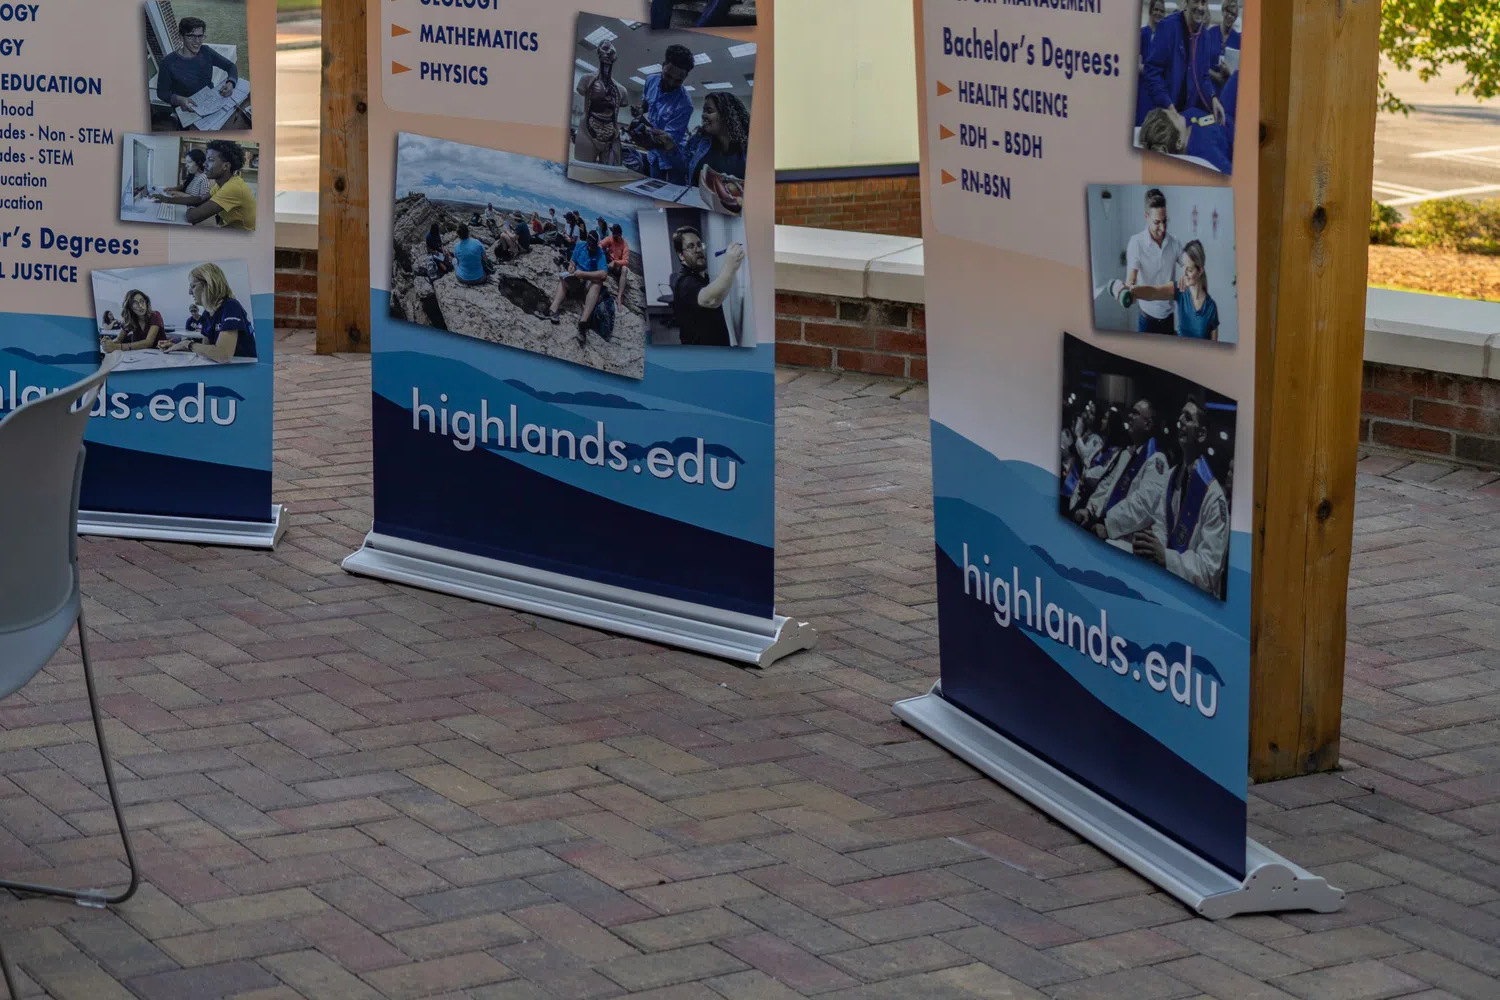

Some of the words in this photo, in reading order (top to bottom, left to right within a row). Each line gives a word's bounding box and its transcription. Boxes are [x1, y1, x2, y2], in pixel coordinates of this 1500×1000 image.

[419, 23, 538, 51] MATHEMATICS
[1041, 36, 1119, 79] Degrees:
[0, 73, 101, 95] EDUCATION
[420, 61, 488, 86] PHYSICS
[958, 78, 1007, 106] HEALTH
[1012, 87, 1067, 118] SCIENCE
[38, 126, 65, 141] Non
[78, 127, 113, 144] STEM
[960, 123, 986, 150] RDH
[1004, 127, 1042, 156] BSDH
[38, 148, 73, 164] STEM
[961, 168, 1010, 197] RN-BSN
[39, 226, 139, 258] Degrees:
[11, 262, 76, 283] JUSTICE
[412, 386, 738, 490] highlands.edu
[961, 542, 1218, 718] highlands.edu
